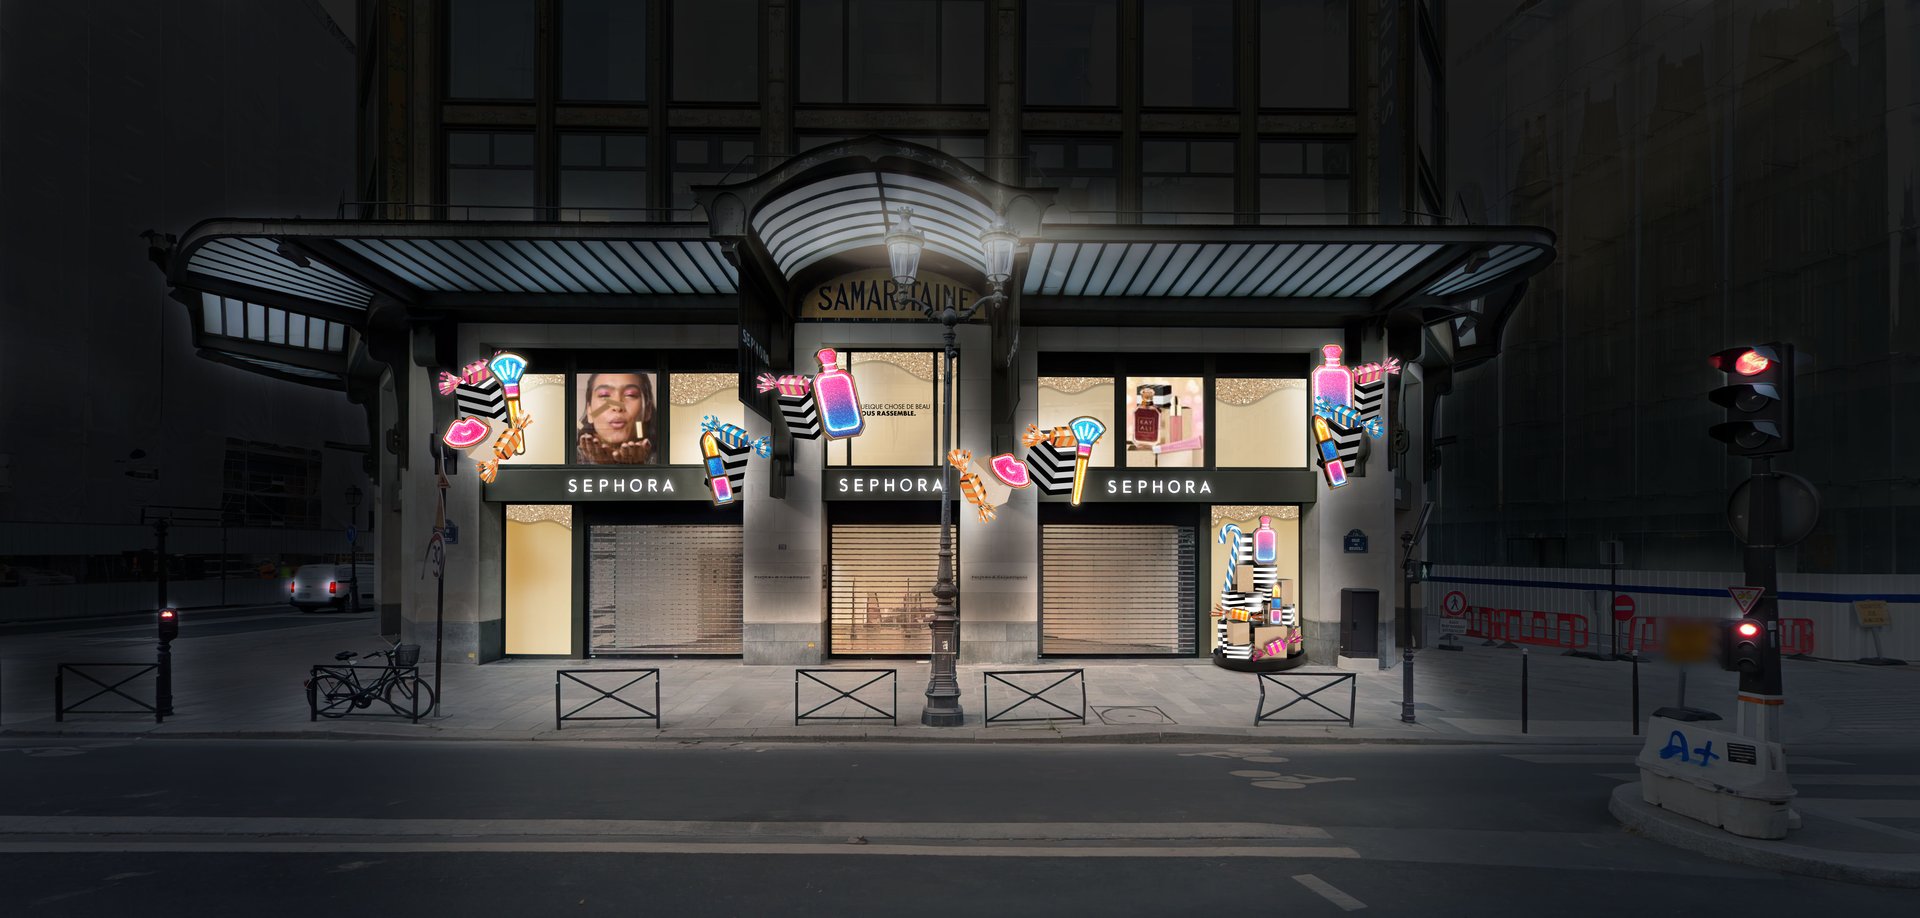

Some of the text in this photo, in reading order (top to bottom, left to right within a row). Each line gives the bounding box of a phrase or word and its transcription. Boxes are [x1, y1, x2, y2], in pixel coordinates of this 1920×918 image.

[818, 280, 973, 311] SAMARTAINE
[567, 478, 675, 493] SEPHORA
[839, 478, 943, 492] SEPHORA
[1107, 479, 1212, 494] SEPHORA
[1660, 730, 1720, 766] A+
